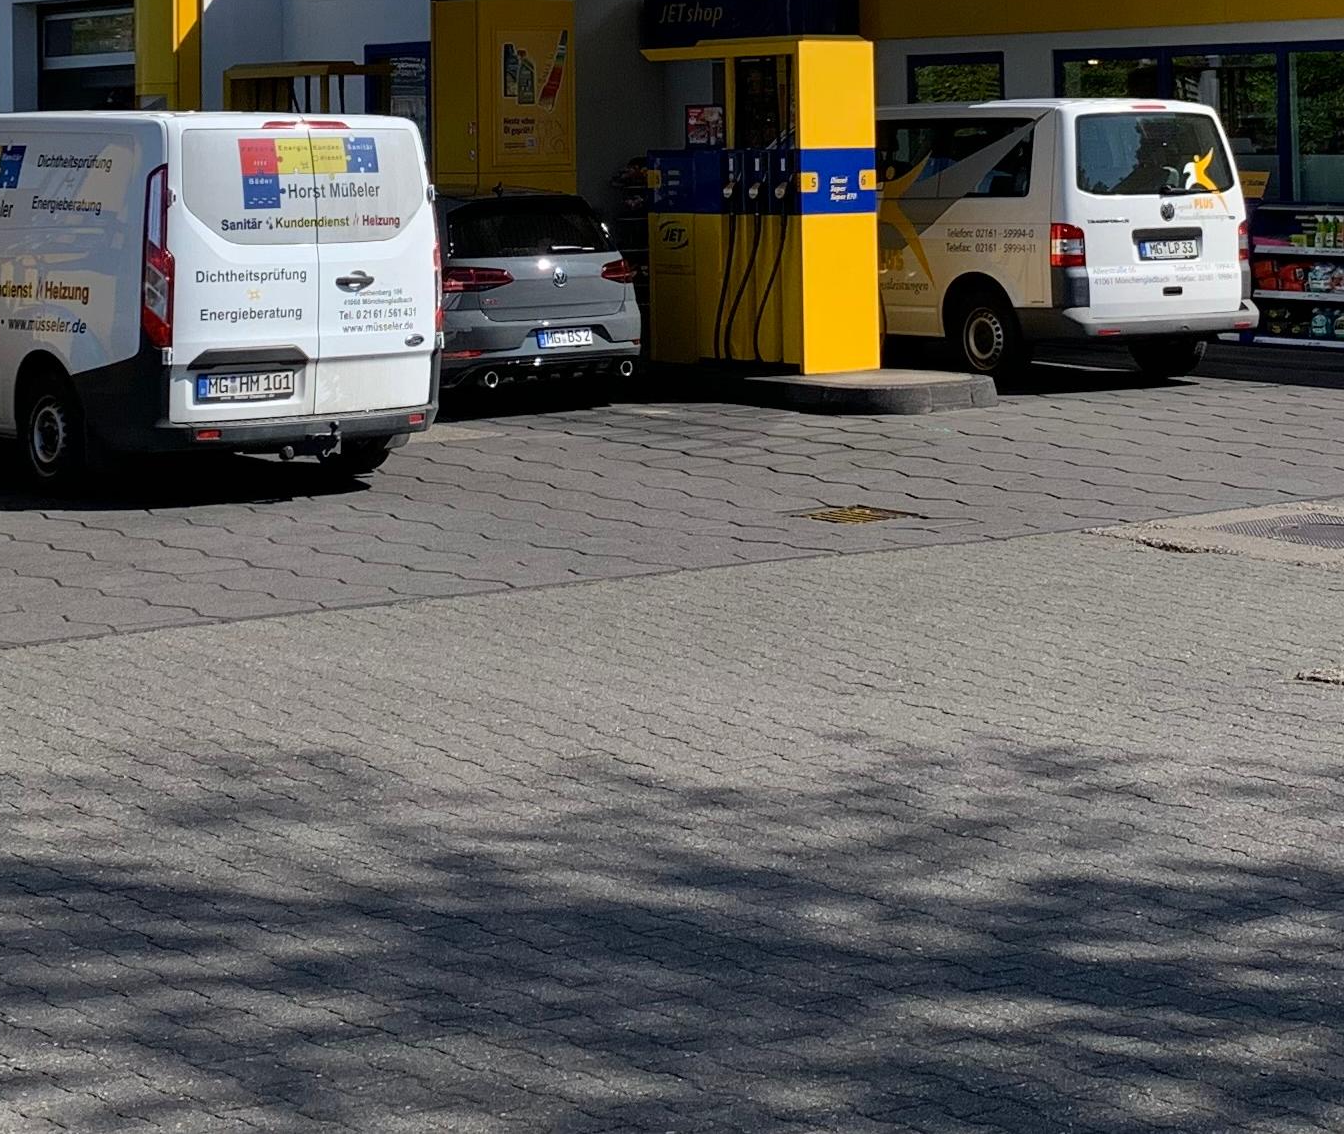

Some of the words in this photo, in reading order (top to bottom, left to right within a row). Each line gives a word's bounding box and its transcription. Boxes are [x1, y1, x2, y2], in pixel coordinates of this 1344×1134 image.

[37, 153, 112, 172] Dichtheitsprüfung
[288, 183, 326, 199] Horst
[330, 181, 380, 198] Müßeler
[811, 177, 816, 188] 5
[32, 195, 102, 216] Energieberatung
[221, 217, 263, 231] Sanitär
[276, 216, 349, 229] Kundendienst
[362, 214, 400, 228] Heizung
[1150, 243, 1162, 254] MG
[1167, 242, 1179, 254] LP
[1182, 241, 1193, 253] 33
[196, 268, 307, 284] Dichtheitsprüfung
[45, 280, 89, 305] Heizung
[200, 307, 302, 323] Energieberatung
[339, 310, 353, 320] Tel.
[7, 316, 87, 333] www.müsseler.de
[342, 321, 413, 333] www.müsseler.de
[546, 331, 561, 344] MG
[567, 330, 582, 343] BS
[585, 329, 591, 342] 2
[209, 377, 228, 394] MG
[240, 375, 259, 392] HM
[264, 374, 291, 391] 101
